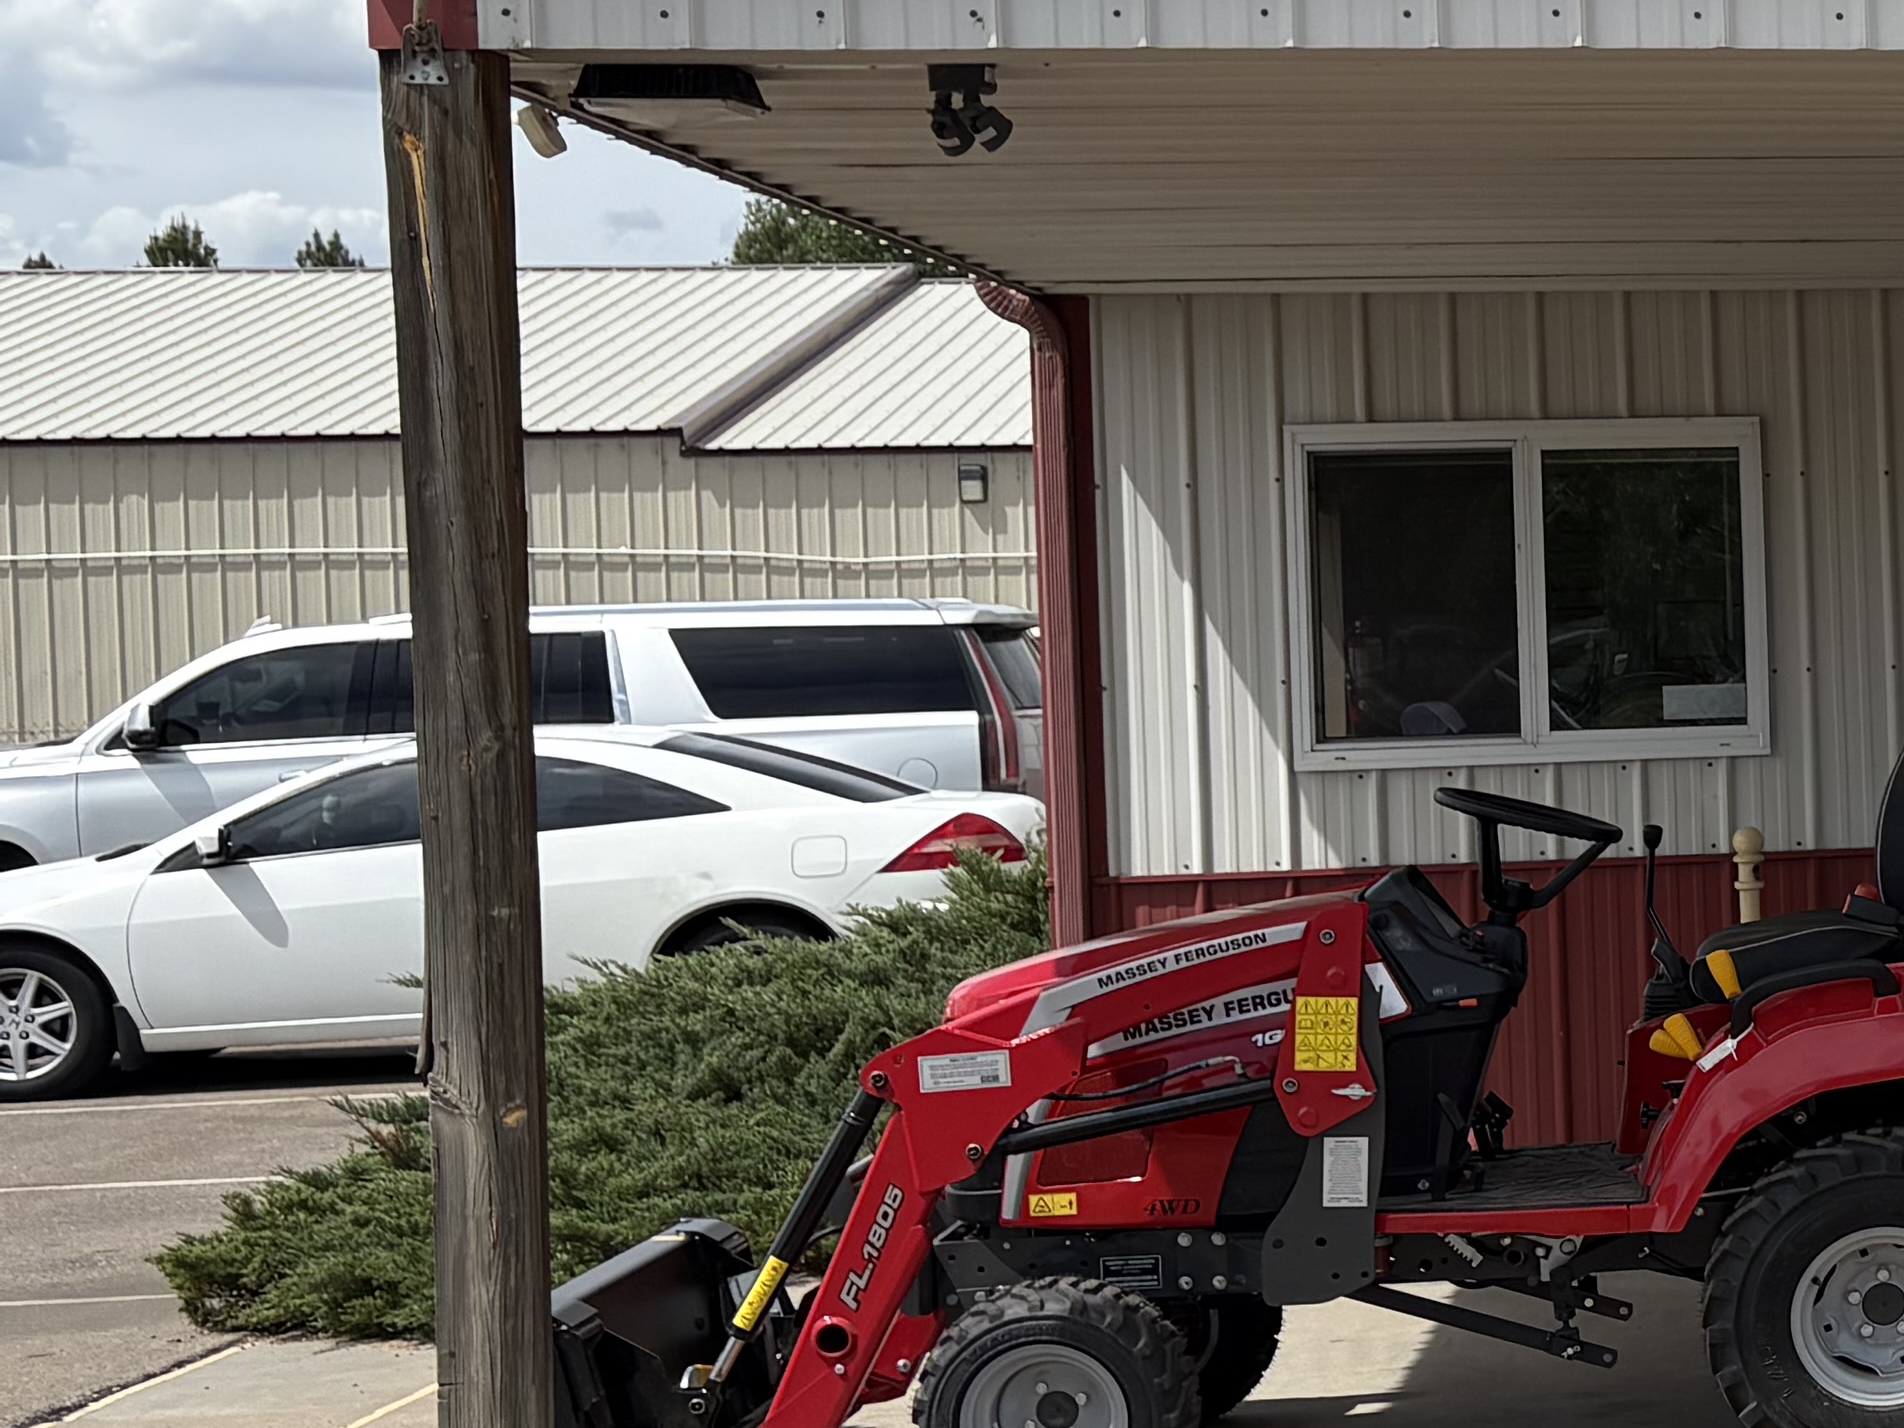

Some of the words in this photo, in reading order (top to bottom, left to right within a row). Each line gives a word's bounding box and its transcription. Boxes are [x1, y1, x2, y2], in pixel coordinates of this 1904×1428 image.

[1097, 958, 1168, 990] MASSEY
[1174, 932, 1268, 966] FERGUSON
[1122, 1005, 1217, 1042] MASSEY
[1143, 1198, 1201, 1215] 4WD
